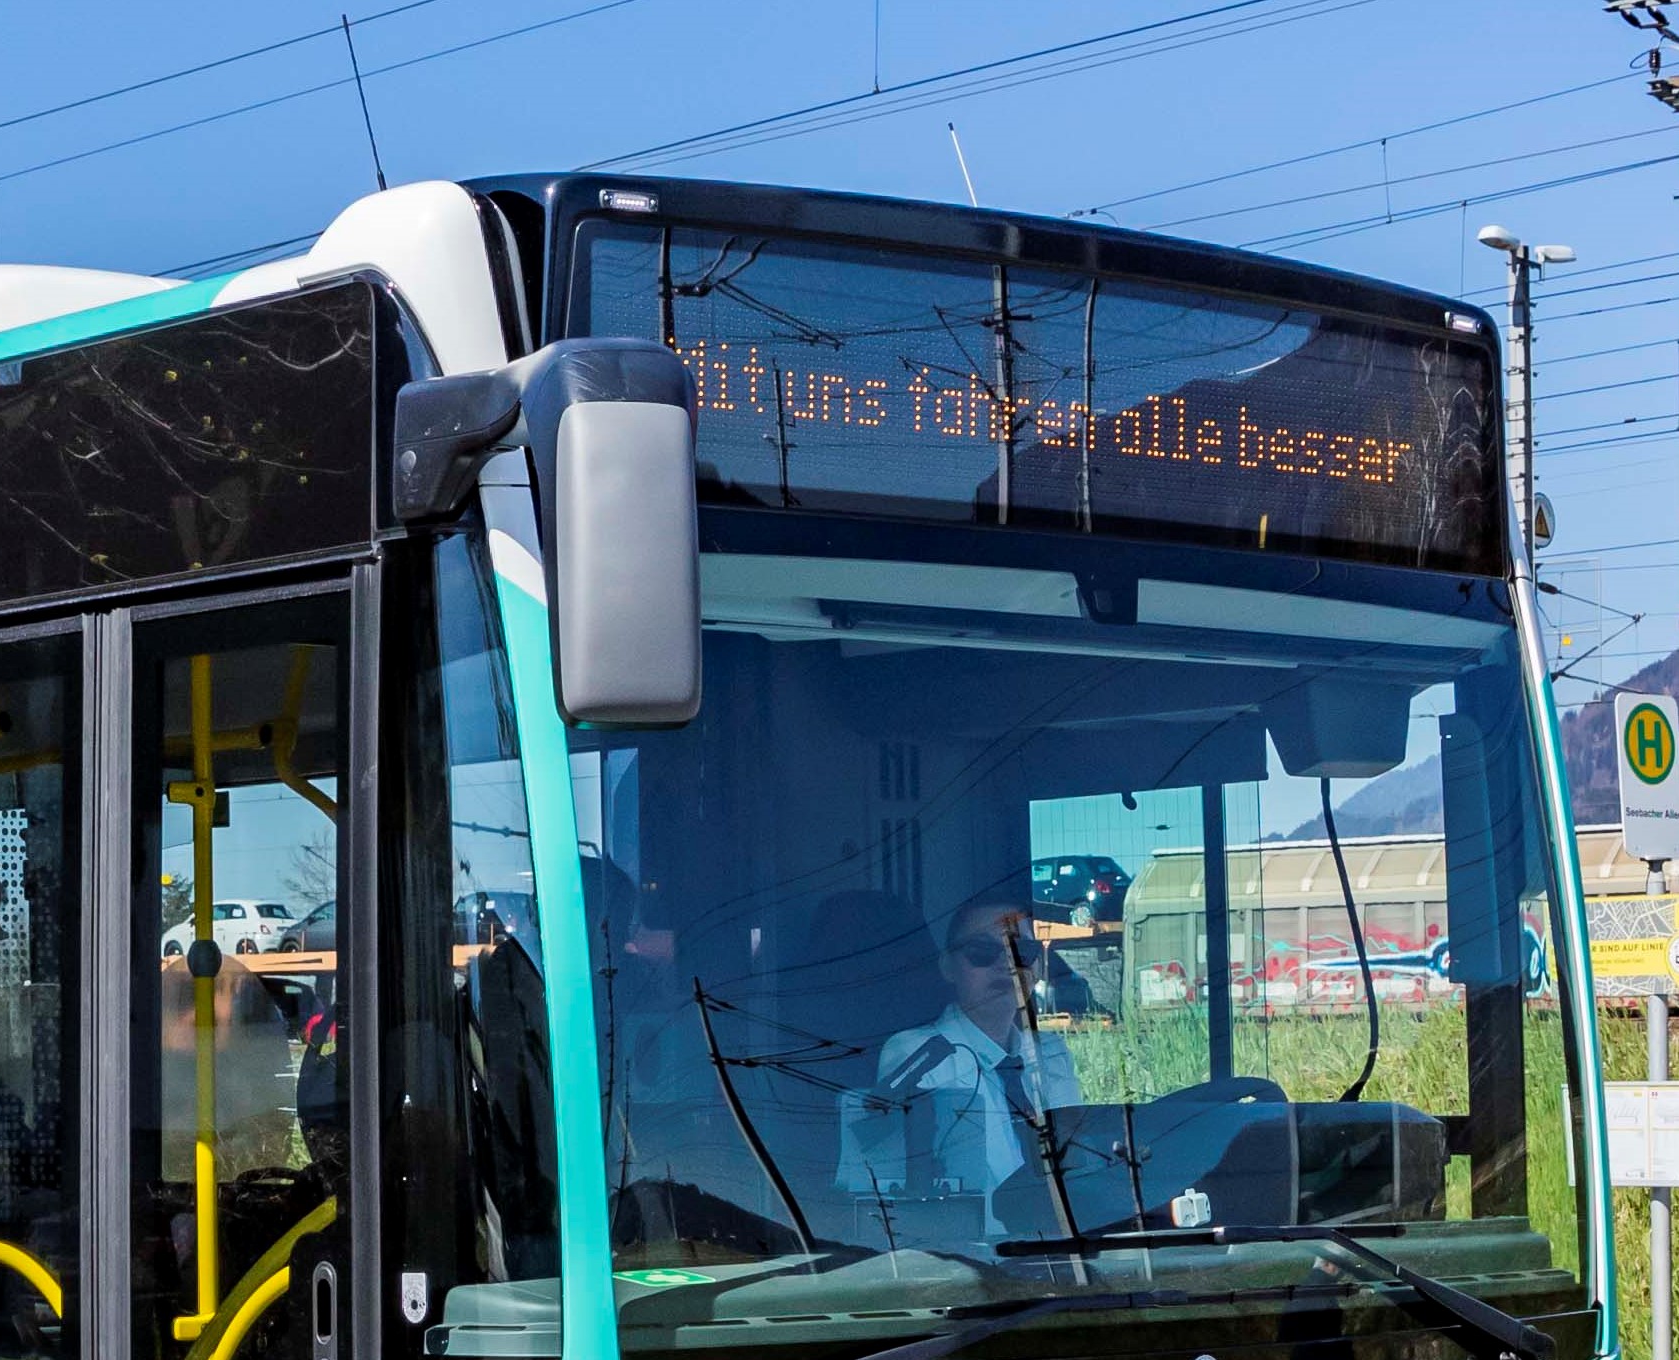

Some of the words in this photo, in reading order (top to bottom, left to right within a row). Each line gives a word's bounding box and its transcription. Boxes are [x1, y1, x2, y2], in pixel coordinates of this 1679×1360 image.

[786, 370, 887, 427] uns
[908, 367, 1096, 450] fahren
[1115, 395, 1222, 464] alle
[1239, 405, 1412, 483] besser
[1637, 718, 1663, 768] H
[1622, 943, 1639, 952] AUF
